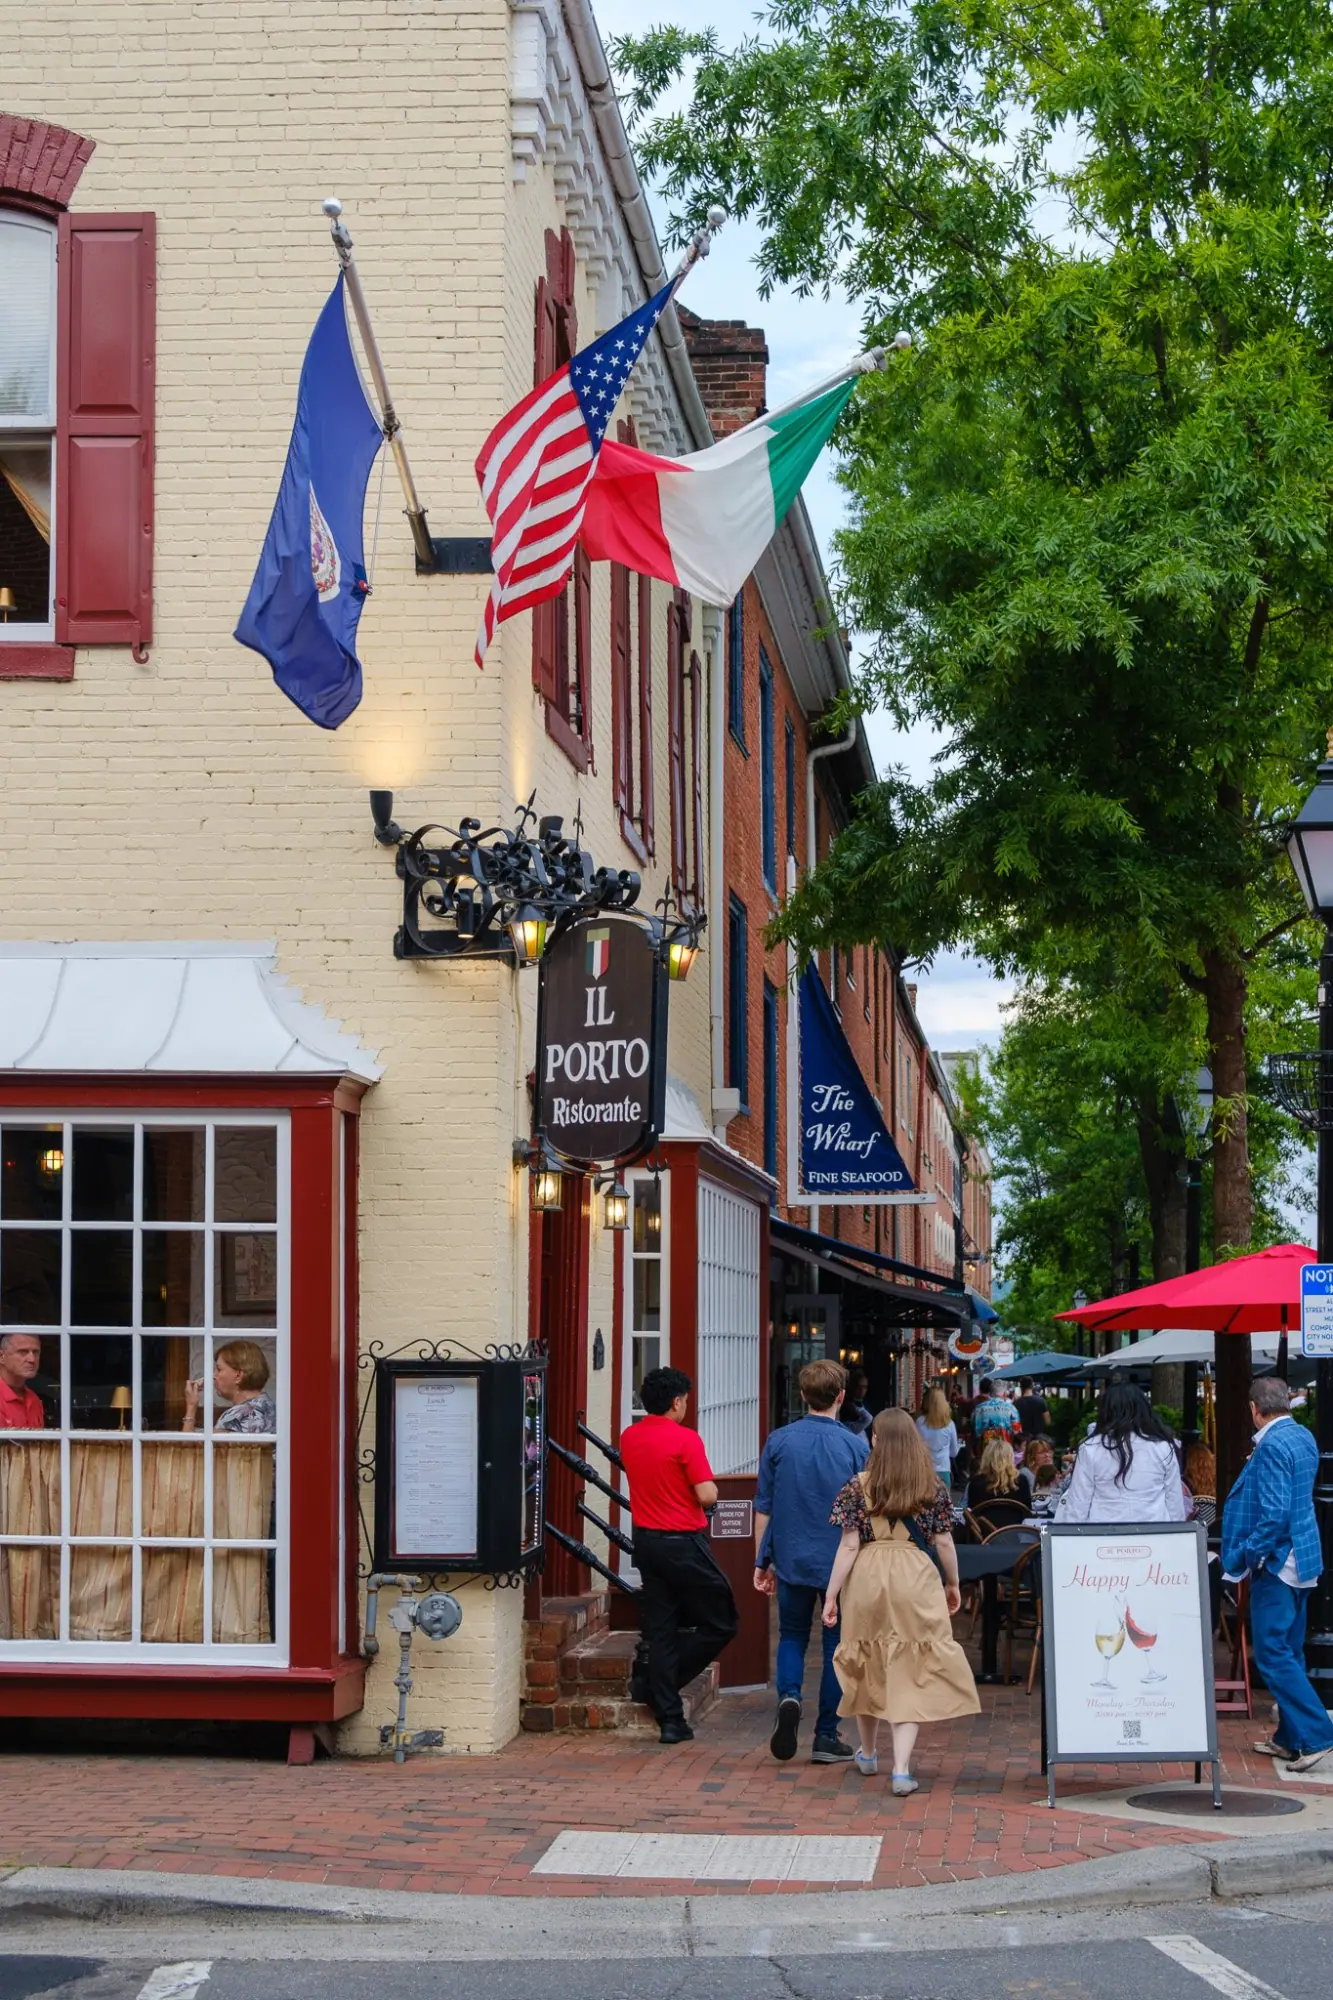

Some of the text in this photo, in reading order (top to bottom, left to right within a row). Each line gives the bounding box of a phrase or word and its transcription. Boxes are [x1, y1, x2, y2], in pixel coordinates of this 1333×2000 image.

[584, 986, 615, 1027] IL
[545, 1037, 650, 1084] PORTO
[552, 1095, 641, 1127] Ristorante
[811, 1084, 854, 1113] The
[806, 1122, 881, 1159] Wharf
[808, 1171, 903, 1183] FINE SEAFOOD
[1061, 1562, 1189, 1592] Happy Hour
[1086, 1697, 1123, 1709] Monday
[1131, 1697, 1176, 1709] Thursday
